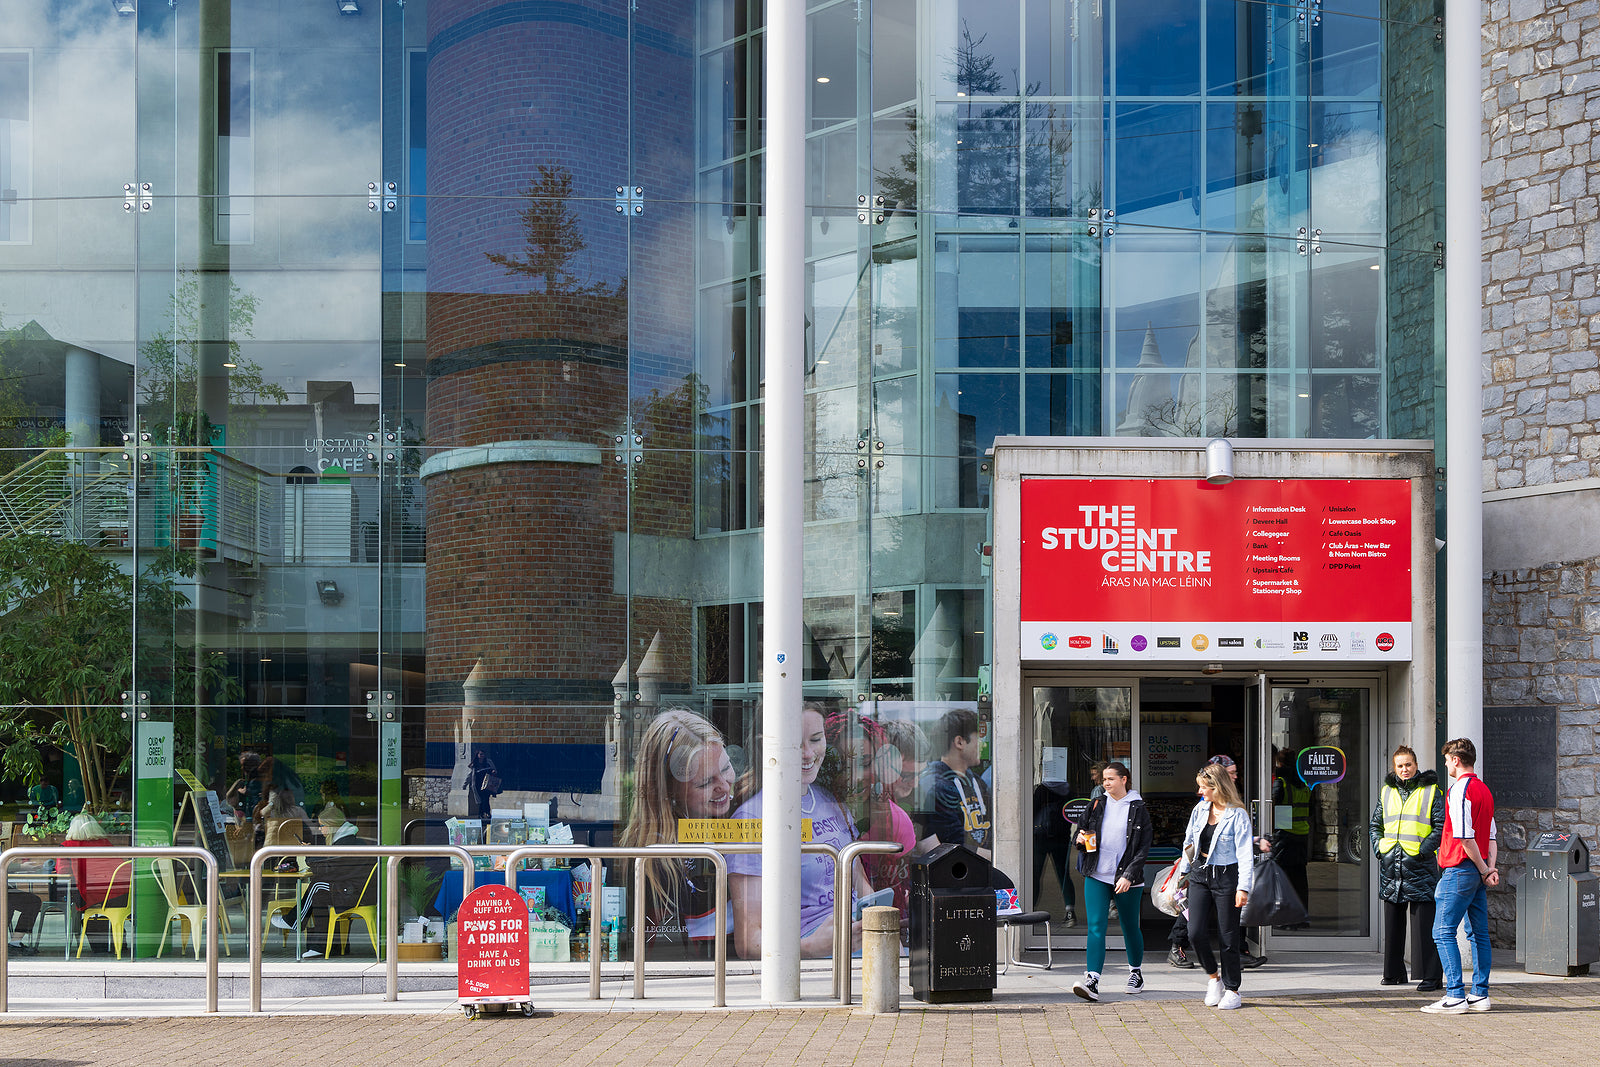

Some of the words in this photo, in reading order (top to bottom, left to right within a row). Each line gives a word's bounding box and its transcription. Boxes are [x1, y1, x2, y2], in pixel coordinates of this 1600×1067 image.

[318, 454, 363, 472] CAFÉ
[1079, 505, 1135, 527] THE
[1380, 518, 1396, 526] Shop
[1041, 527, 1178, 550] STUDENT
[1344, 541, 1359, 549] Áras
[1101, 551, 1211, 572] CENTRE
[1101, 575, 1131, 587] ÁRAS
[1133, 577, 1149, 587] NA
[1152, 577, 1177, 587] MAC
[1179, 575, 1212, 587] LÉINN
[1252, 579, 1292, 587] Supermarket
[1293, 631, 1309, 641] NB
[148, 737, 158, 746] OUR
[1148, 736, 1168, 744] BUS
[149, 747, 163, 756] GREEN
[1148, 745, 1201, 753] CONNECTS
[145, 757, 166, 766] JOURNEY
[1308, 752, 1336, 765] FÁILTE
[688, 822, 731, 830] OFFICIAL
[476, 899, 502, 907] HAVING
[473, 906, 491, 914] RUFF
[946, 909, 984, 919] LITTER
[501, 919, 522, 931] FOR
[467, 933, 475, 944] A
[480, 932, 519, 944] DRINK!
[479, 950, 499, 958] HAVE
[502, 950, 509, 958] A
[467, 960, 492, 968] DRINK
[495, 959, 506, 967] ON
[509, 958, 521, 966] US
[940, 966, 990, 977] BRUSCAR
